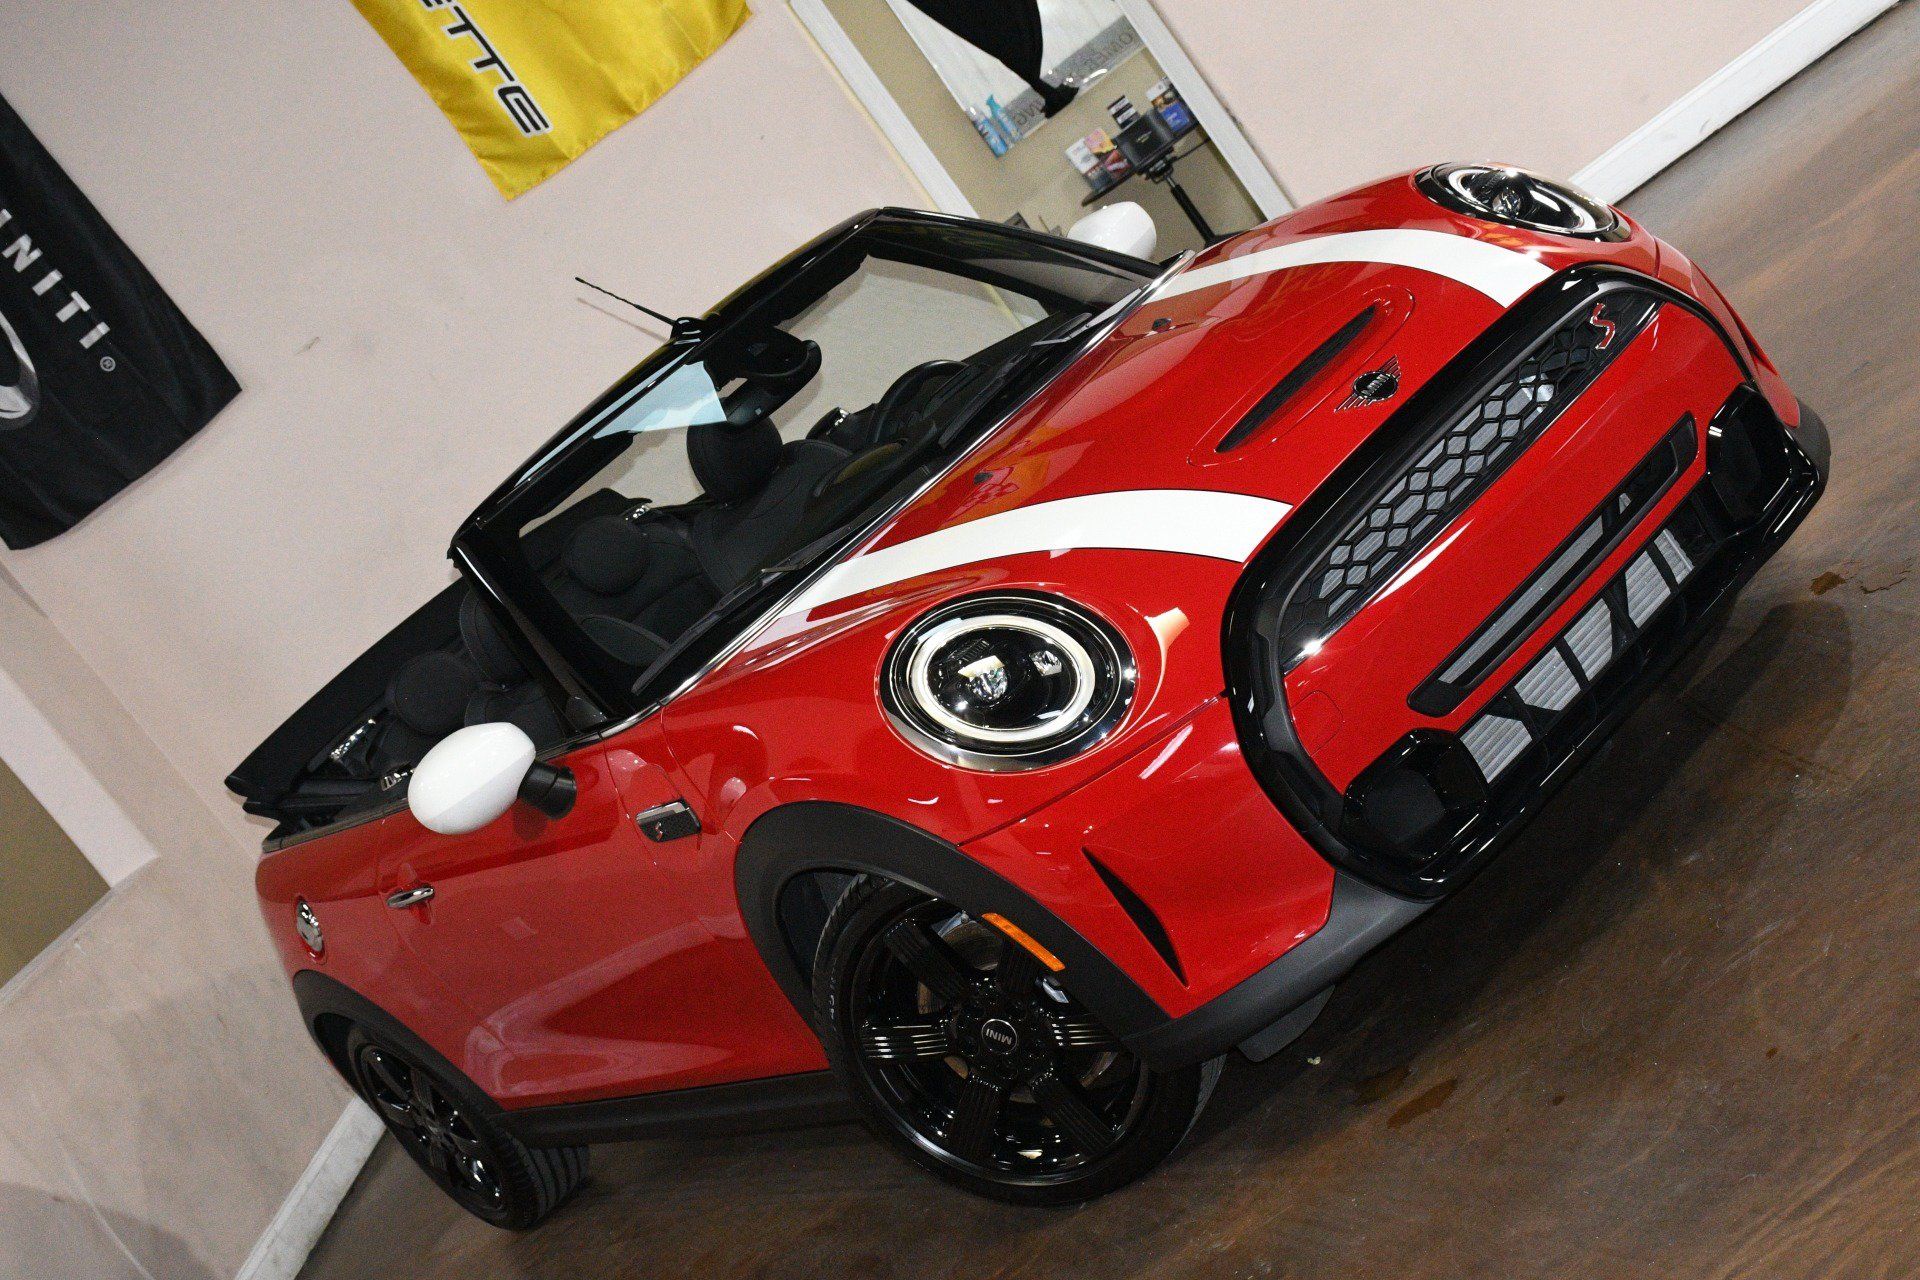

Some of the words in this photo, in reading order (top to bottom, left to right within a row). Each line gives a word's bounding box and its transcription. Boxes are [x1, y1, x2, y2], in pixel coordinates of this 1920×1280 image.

[422, 0, 551, 135] TTE
[1590, 302, 1616, 350] S
[1360, 373, 1390, 397] MINI
[985, 1028, 1013, 1046] MINI
